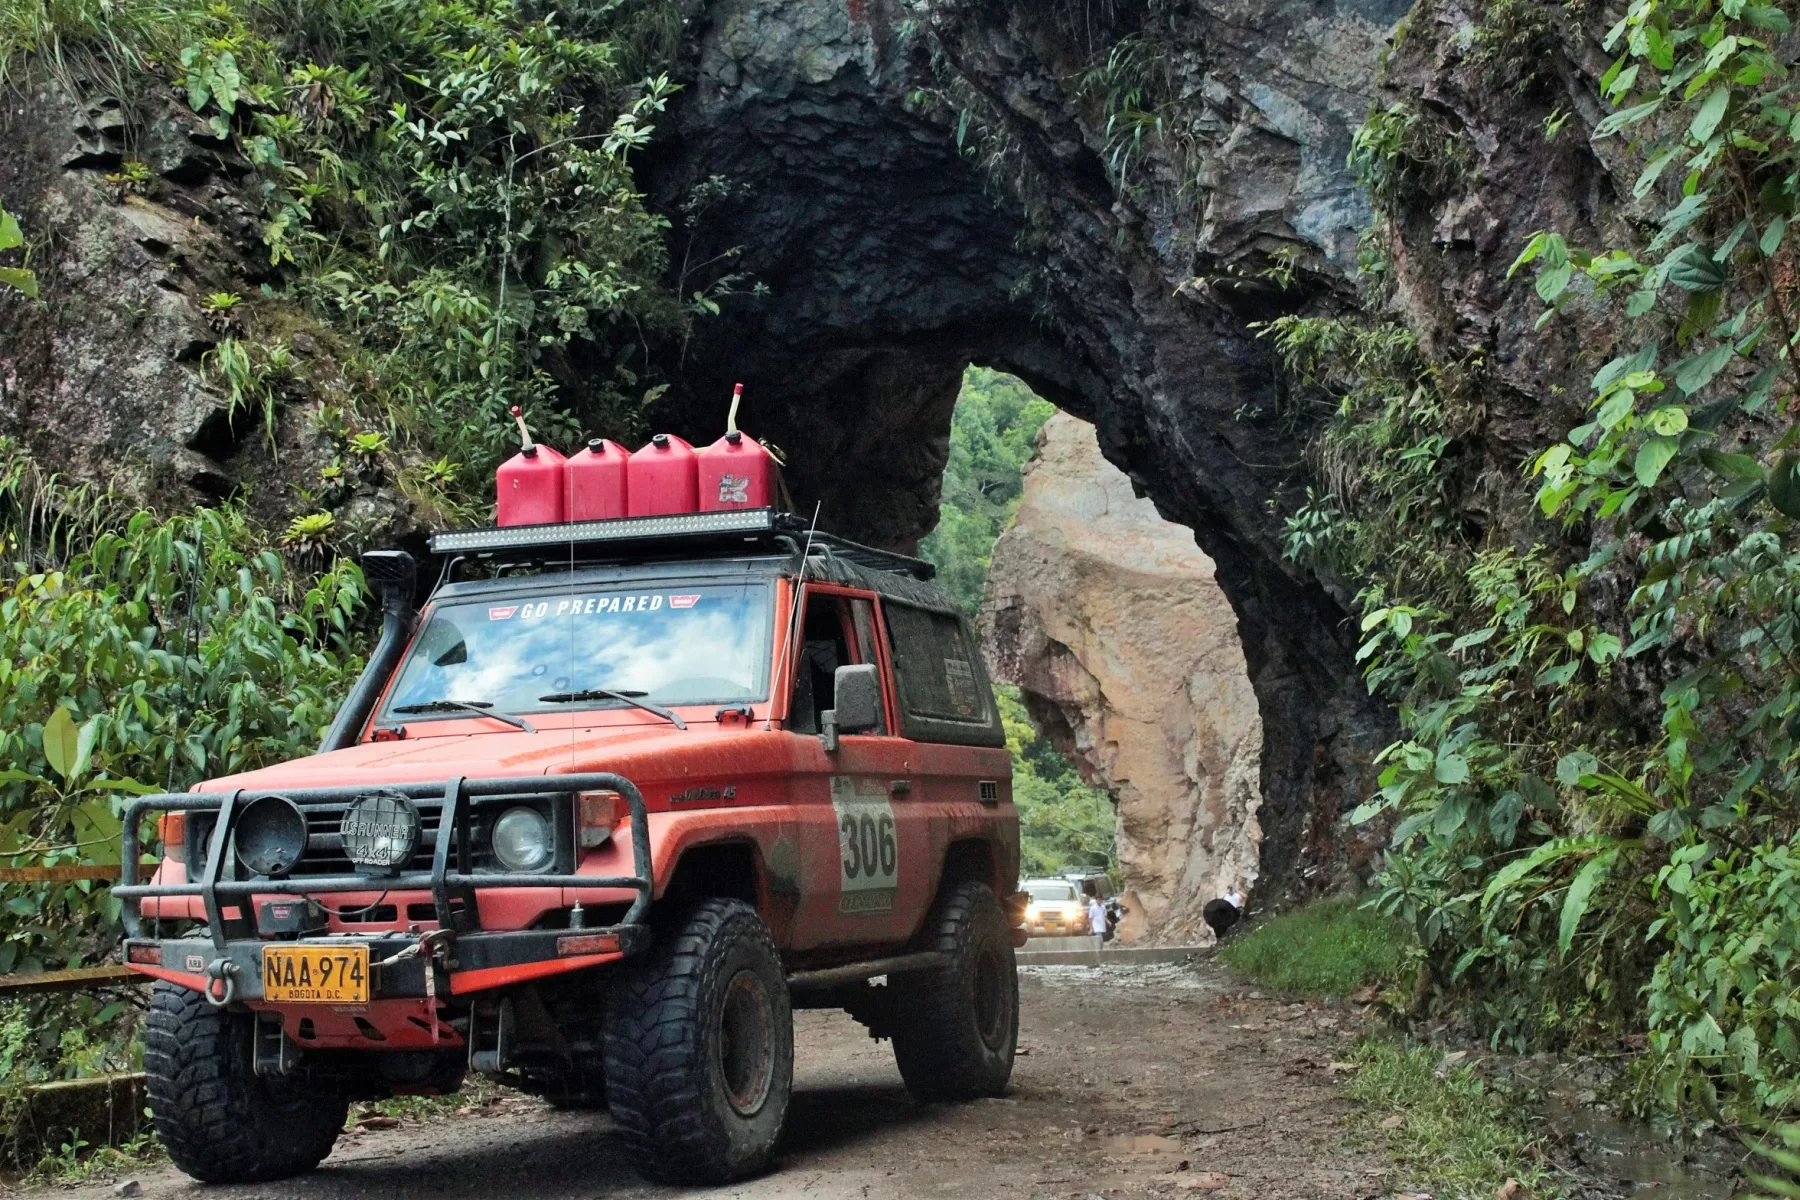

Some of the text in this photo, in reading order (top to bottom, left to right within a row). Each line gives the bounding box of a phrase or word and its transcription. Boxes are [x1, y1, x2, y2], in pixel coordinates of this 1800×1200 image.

[520, 595, 664, 619] GO PREPARED
[841, 812, 896, 879] 306
[364, 858, 391, 866] ROADER
[266, 956, 364, 987] NAA 974
[288, 989, 343, 999] BOGOTA D.C.
